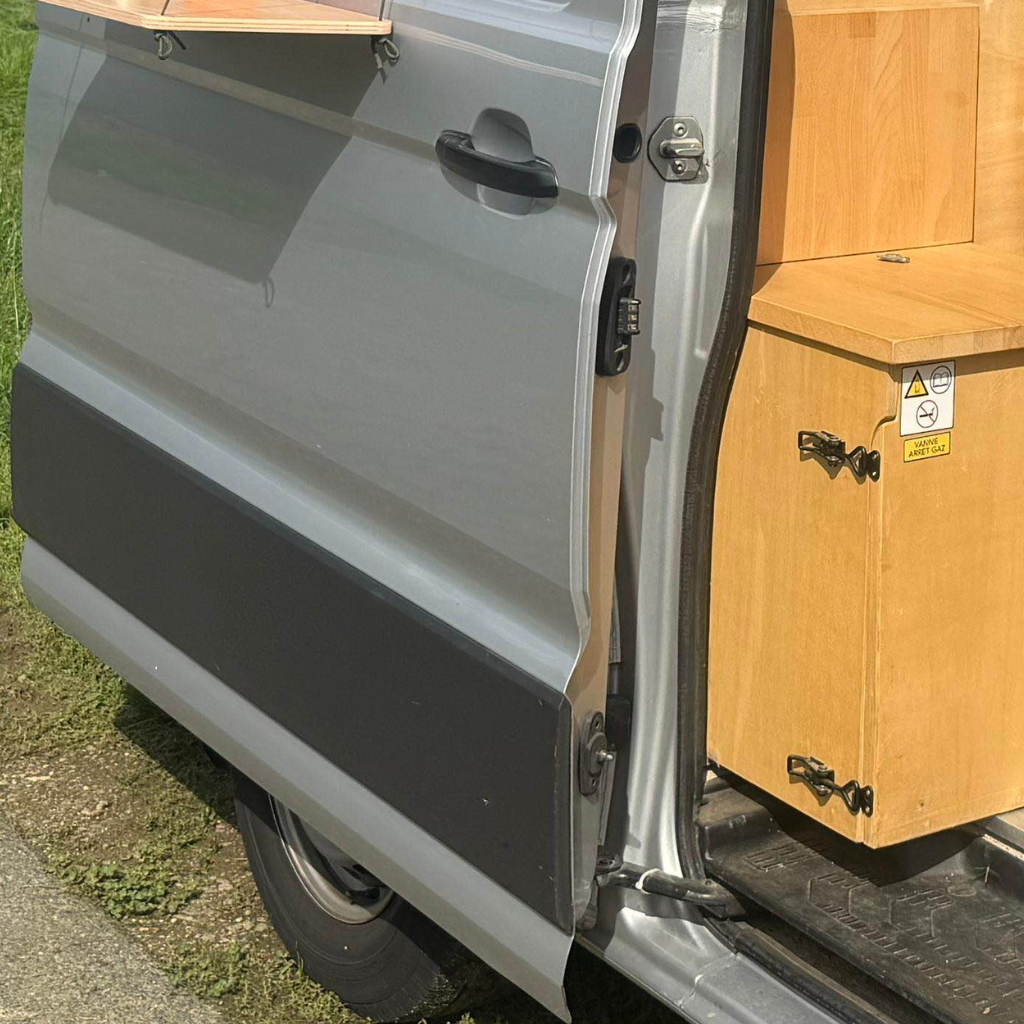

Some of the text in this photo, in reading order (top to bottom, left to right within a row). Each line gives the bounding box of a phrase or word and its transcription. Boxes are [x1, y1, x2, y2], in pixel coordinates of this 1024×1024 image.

[914, 437, 938, 447] VANNE
[909, 444, 946, 457] ARRET GAZ
